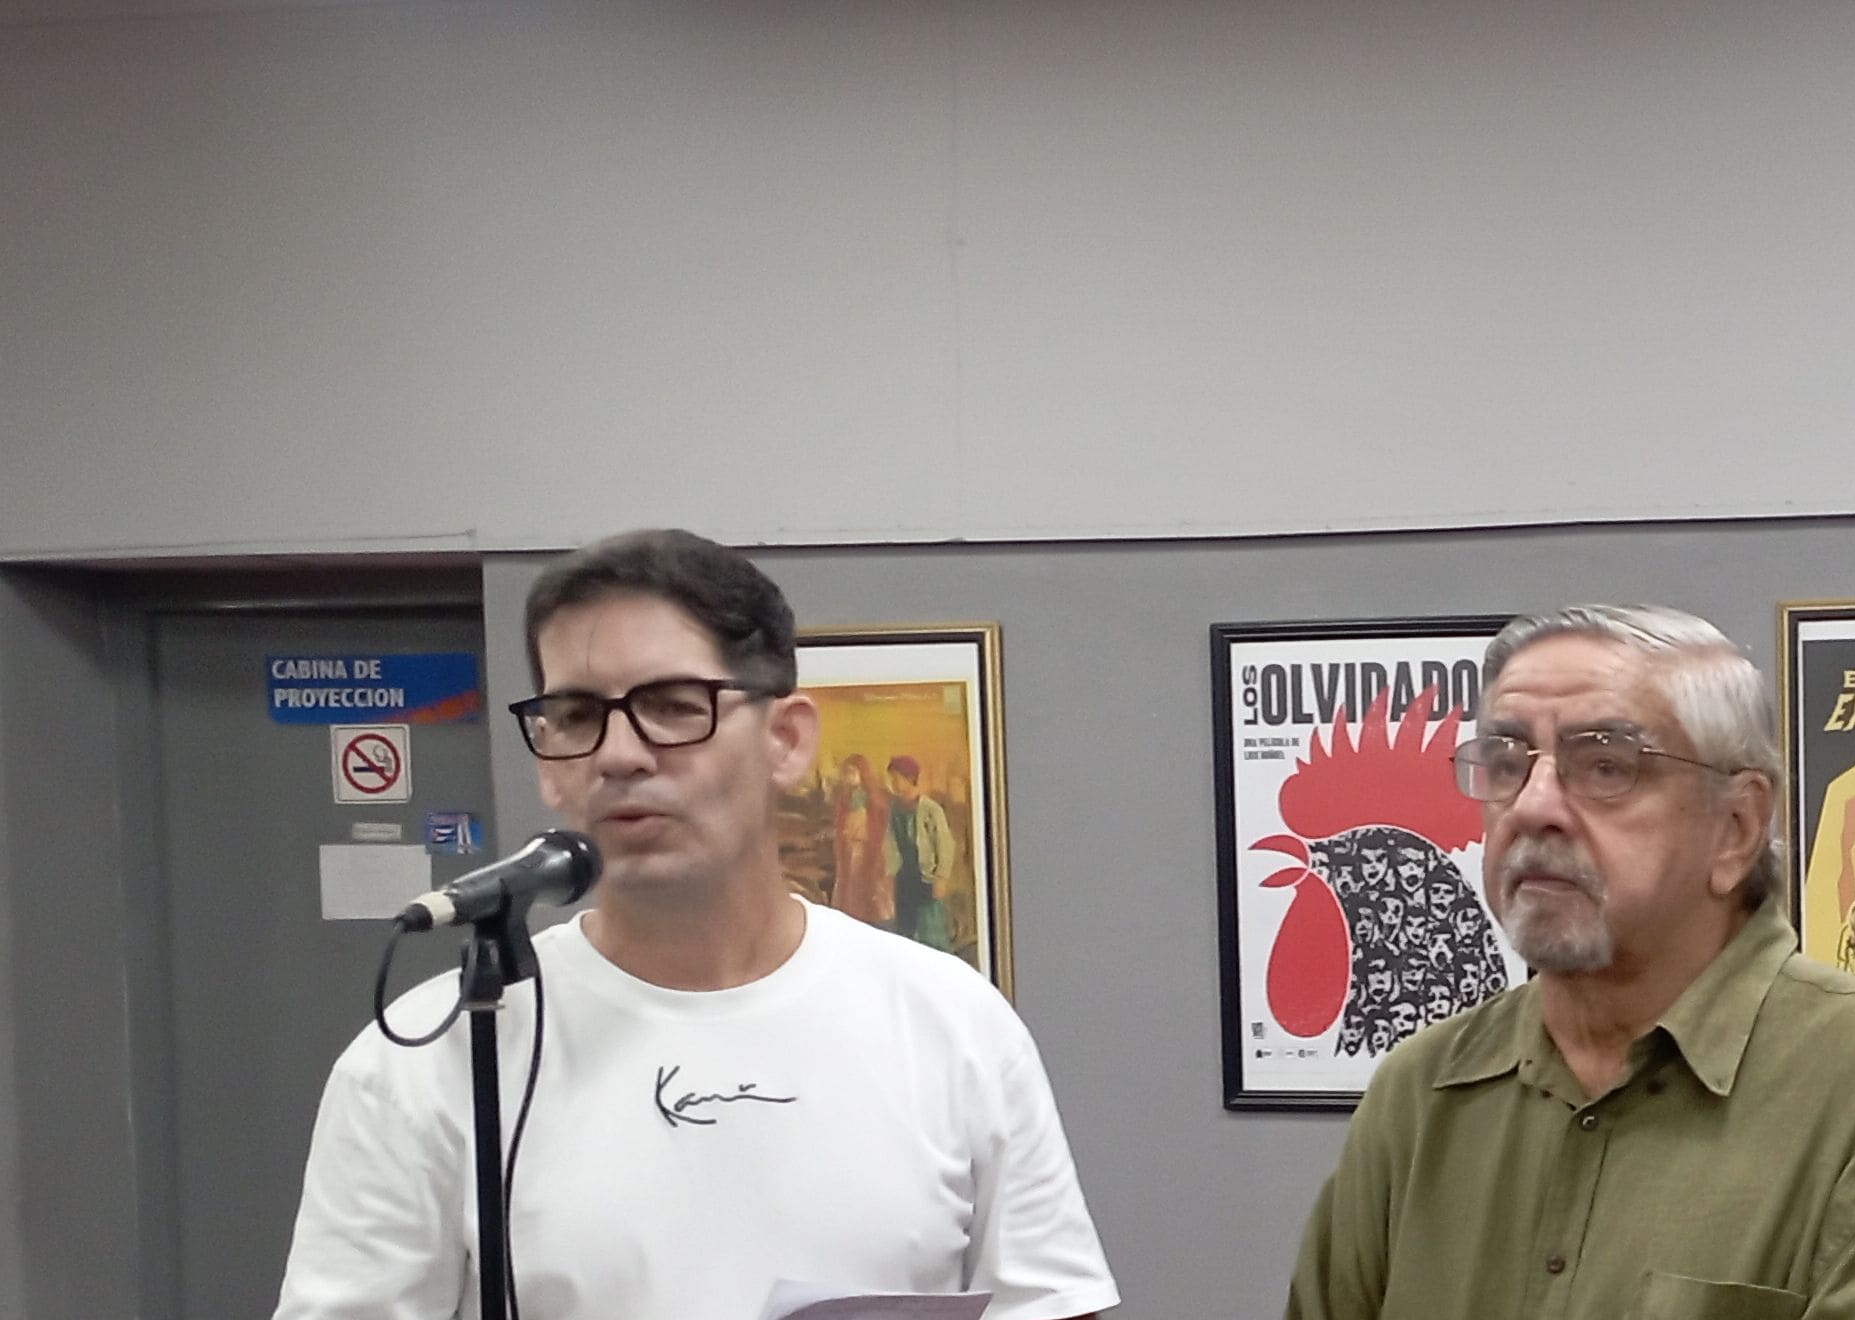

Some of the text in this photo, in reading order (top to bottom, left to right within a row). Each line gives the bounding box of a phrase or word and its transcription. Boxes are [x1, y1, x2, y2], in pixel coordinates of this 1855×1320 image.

[271, 659, 382, 680] CABINA DE
[273, 687, 405, 708] PROYECCION
[1242, 664, 1258, 726] LOS
[1260, 658, 1490, 727] OLVIDADO
